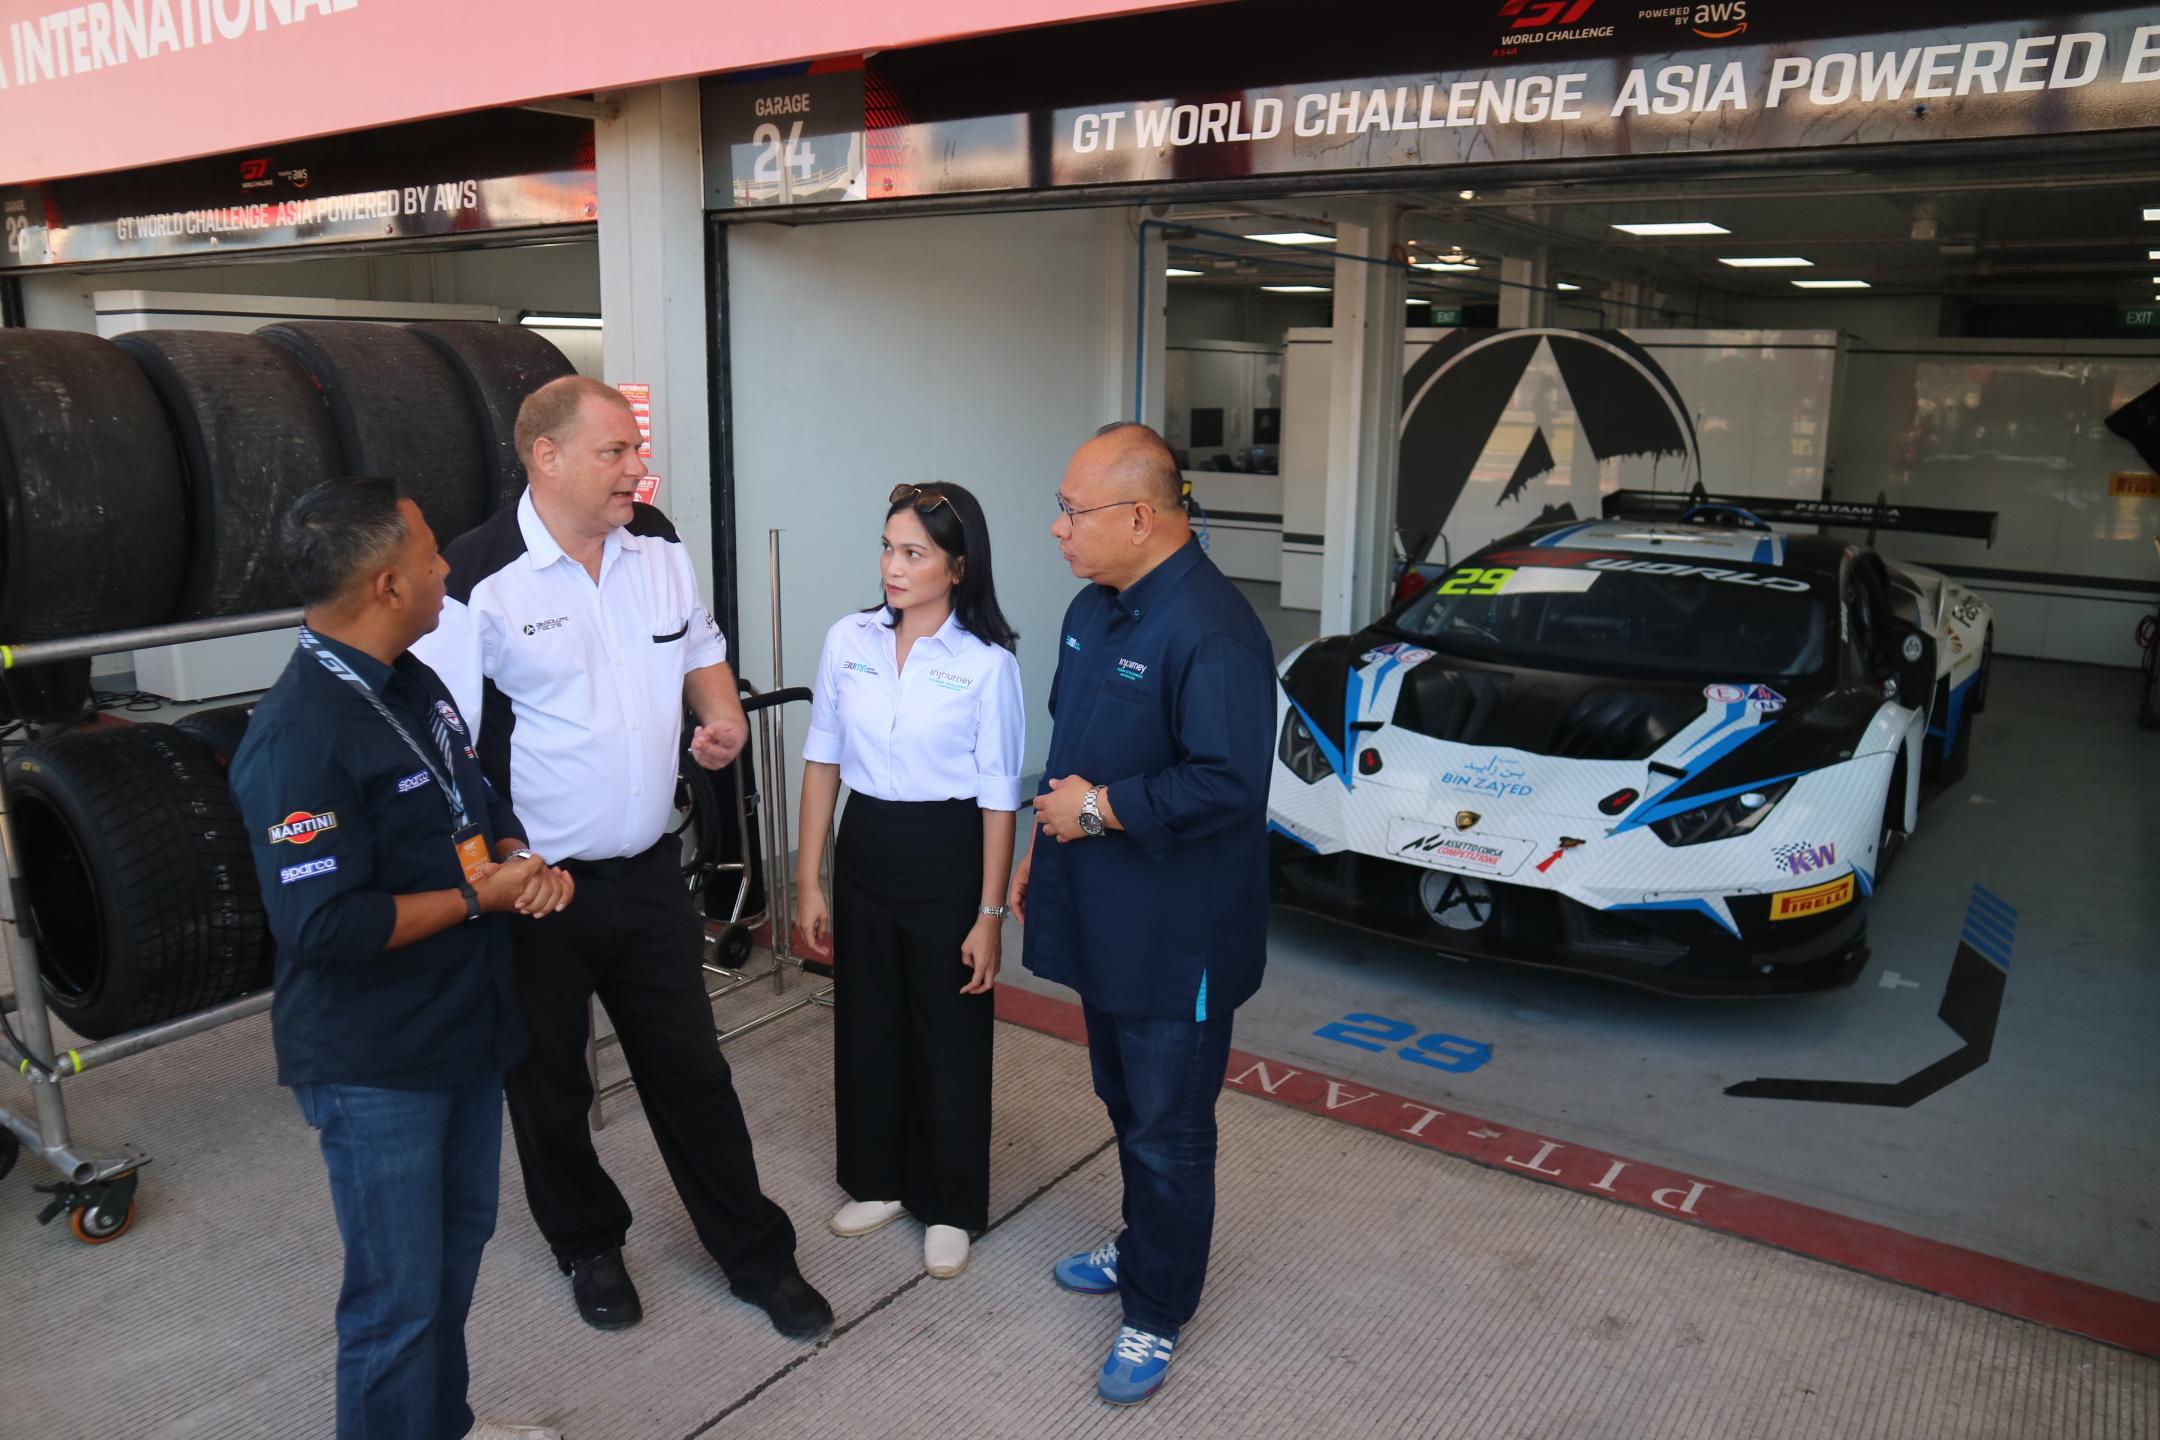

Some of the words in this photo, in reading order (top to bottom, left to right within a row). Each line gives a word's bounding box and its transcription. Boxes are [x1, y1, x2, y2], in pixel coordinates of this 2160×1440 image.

[1639, 6, 1690, 19] POWERED
[1675, 16, 1689, 25] BY
[1694, 1, 1746, 24] aws
[1501, 32, 1545, 46] WORLD
[1546, 26, 1615, 41] CHALLENGE
[755, 93, 811, 117] GARAGE
[1072, 111, 1125, 154] GT
[1134, 98, 1283, 149] WORLD
[1294, 73, 1587, 137] CHALLENGE
[1610, 61, 1748, 116] ASIA
[1765, 32, 2107, 108] POWERED
[752, 120, 816, 181] 24
[117, 217, 135, 240] GT
[135, 211, 184, 239] WORLD
[185, 203, 270, 235] CHALLENGE
[276, 198, 313, 226] ASIA
[317, 189, 400, 224] POWERED
[404, 185, 430, 215] BY
[433, 179, 478, 212] AWS
[2126, 311, 2154, 324] EXIT
[1795, 502, 1901, 517] PERTAMIA
[1436, 567, 1518, 595] 29
[1584, 557, 1811, 593] WORLD
[398, 771, 429, 792] sparco
[1441, 772, 1472, 785] BIN
[1473, 777, 1533, 799] ZAYED
[271, 814, 334, 841] MARTINI
[1437, 847, 1500, 865] COMPETIZIONE
[1443, 840, 1478, 852] ASSETTO
[1477, 845, 1504, 857] CORSA
[1788, 842, 1836, 876] KW
[280, 858, 337, 884] sparco
[1780, 881, 1850, 914] PIRELLI
[1311, 1013, 1496, 1074] 29
